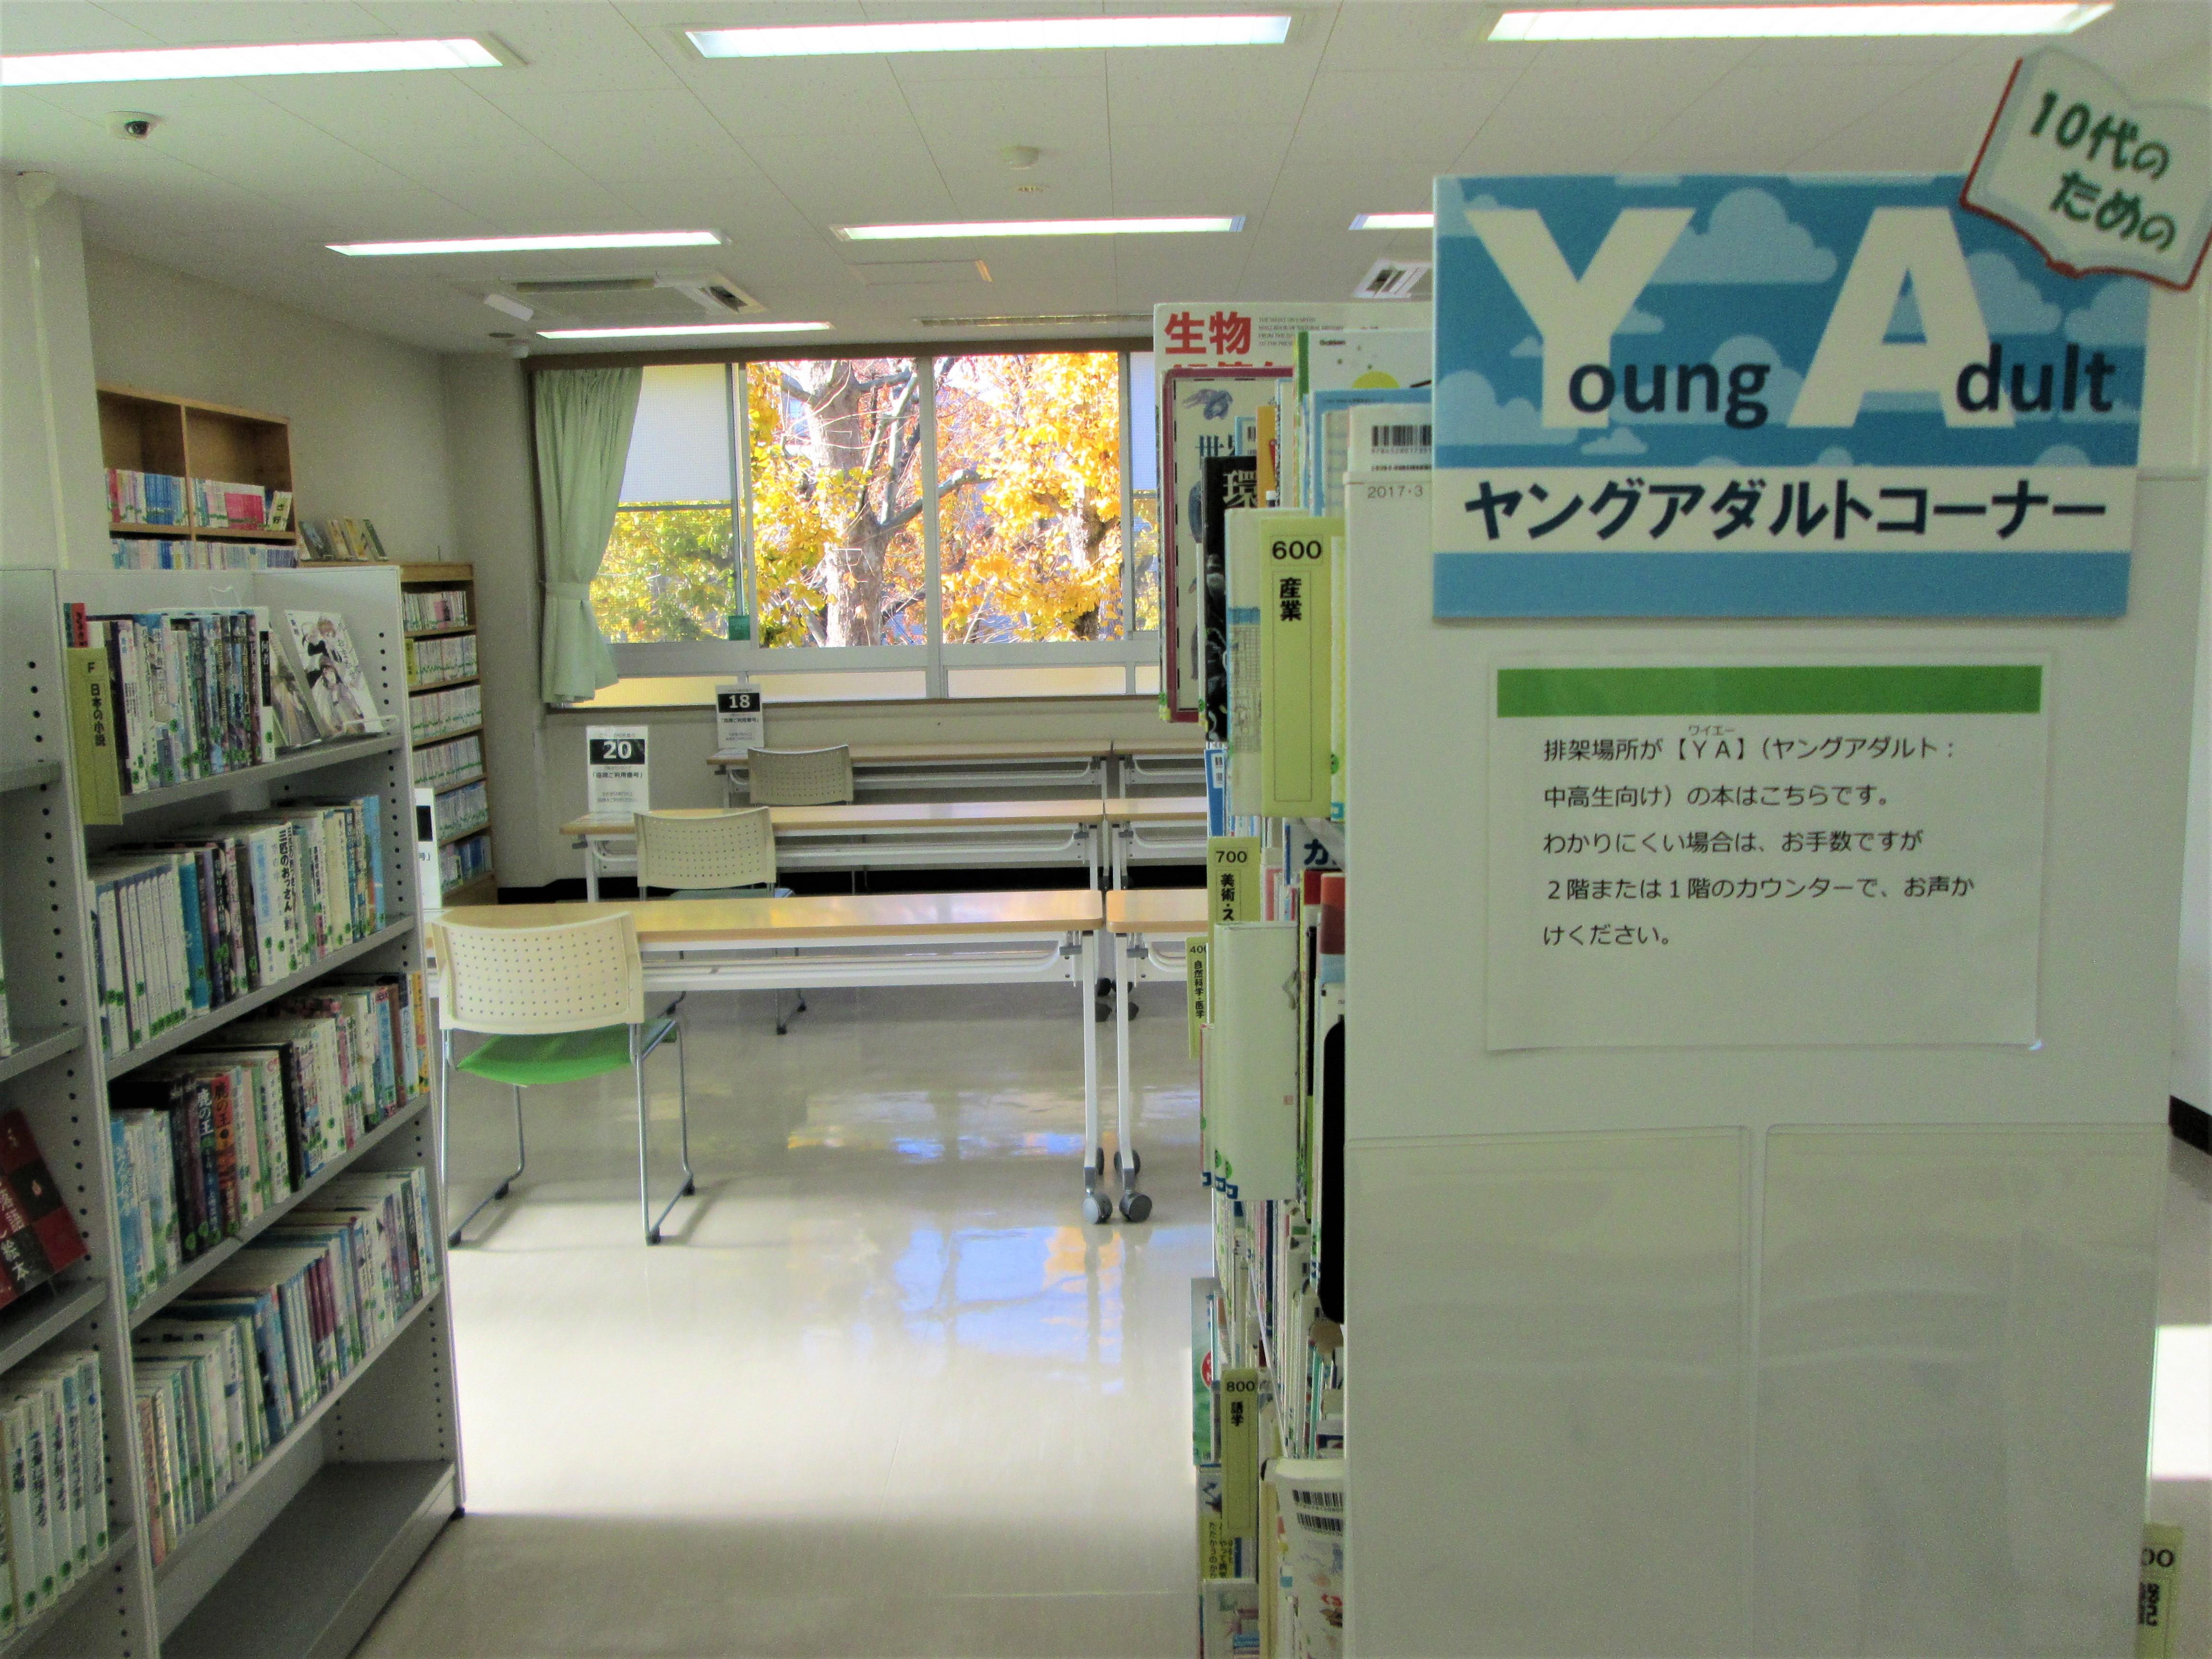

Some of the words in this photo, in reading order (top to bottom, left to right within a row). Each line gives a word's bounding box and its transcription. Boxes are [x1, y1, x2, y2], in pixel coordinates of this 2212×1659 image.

[2030, 88, 2171, 180] 10代の
[2050, 168, 2176, 252] ための
[1164, 310, 1251, 355] 生物
[1465, 477, 2107, 541] ヤングアダルトコーナー
[1272, 540, 1322, 560] 600
[1279, 577, 1302, 622] 産業
[87, 662, 96, 673] F
[729, 694, 750, 709] 18
[90, 684, 106, 747] 日本の小説
[1688, 724, 1736, 737] ワイエー
[603, 741, 632, 759] 20
[1544, 784, 1889, 808] 中高生向け）の本はこちらです。
[1544, 830, 1924, 854] わかりにくい場合は、お手数ですが
[1215, 850, 1248, 864] 700
[278, 829, 292, 913] 三匹のおっさん
[1220, 873, 1236, 921] 美術・ス
[1548, 876, 1974, 900] 2階または1階のカウンターで、お声か
[1544, 924, 1671, 946] けください。
[1194, 960, 1206, 1019] 自然科学・医学
[197, 1088, 214, 1137] 鹿の王
[1226, 1381, 1255, 1393] 800
[1230, 1401, 1244, 1427] 語学
